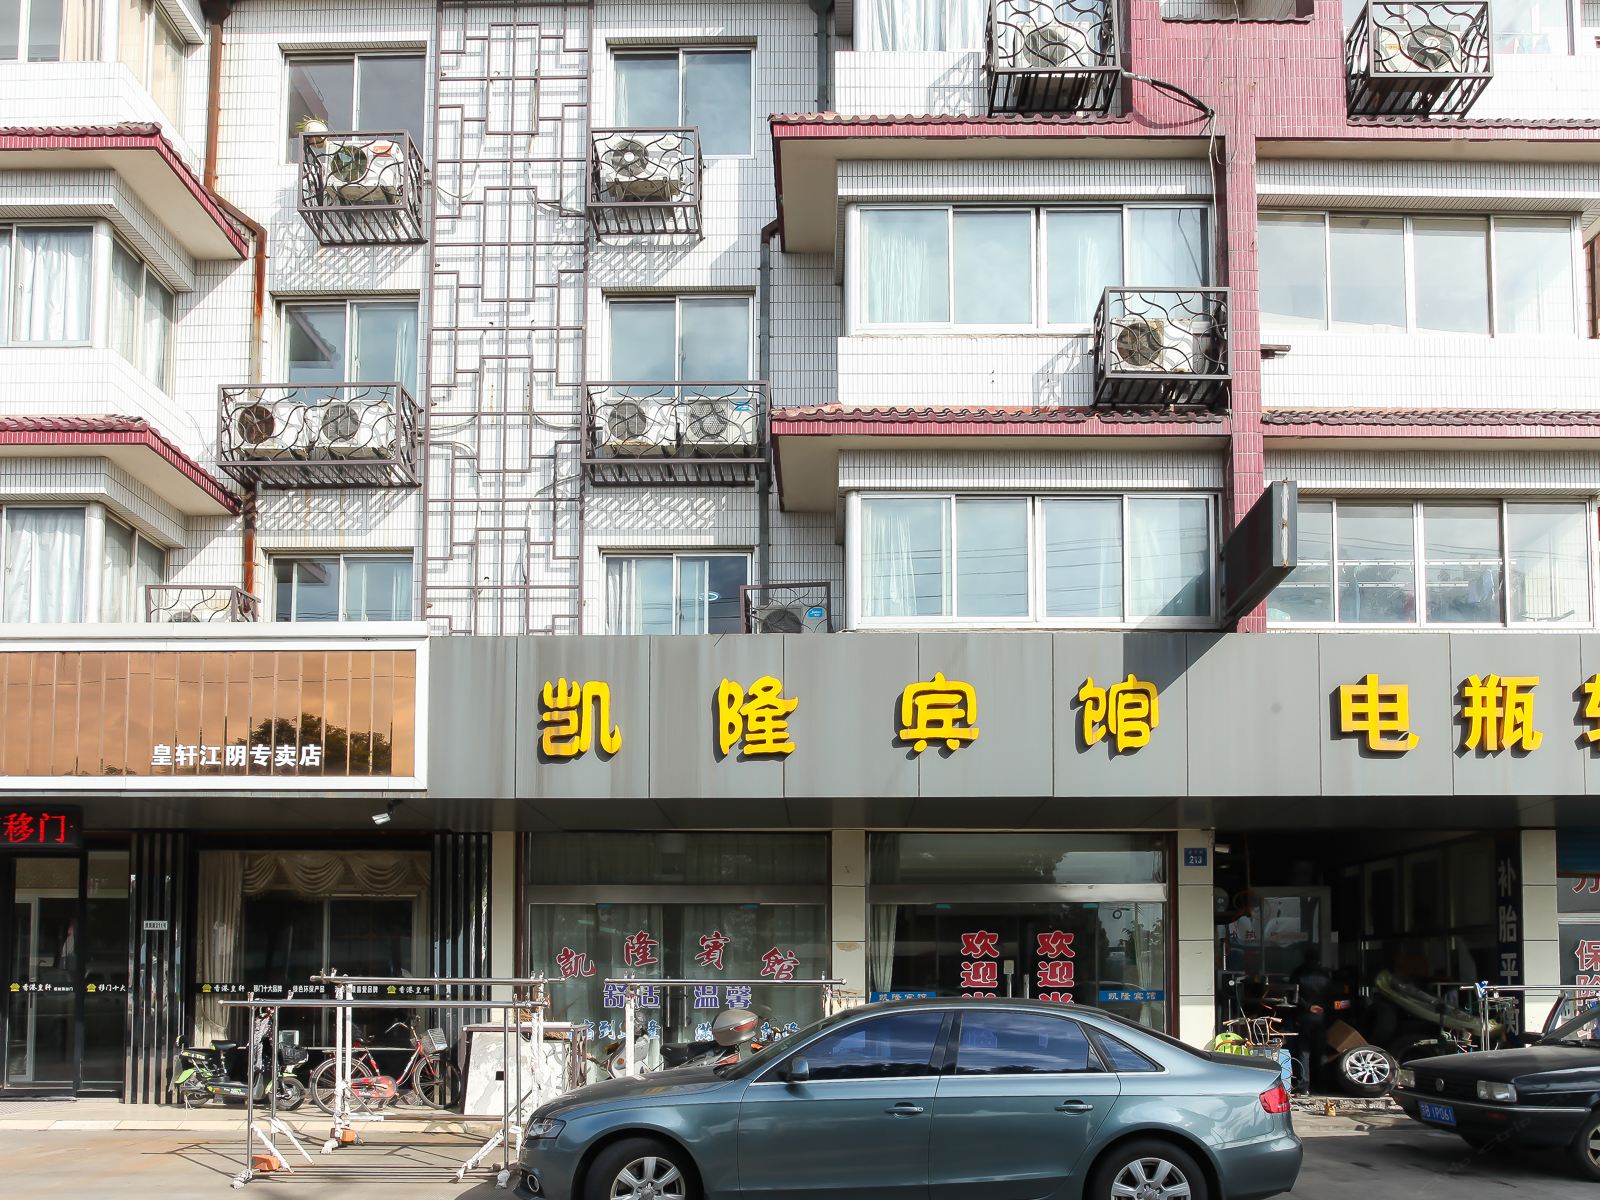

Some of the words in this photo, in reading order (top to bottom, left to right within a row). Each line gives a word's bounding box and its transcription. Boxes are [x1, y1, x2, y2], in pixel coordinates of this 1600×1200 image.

[541, 673, 1160, 757] 凯隆宾馆
[1339, 672, 1600, 752] 电瓶
[150, 743, 323, 768] 皇轩江阴专卖店
[960, 930, 1000, 998] 欢迎
